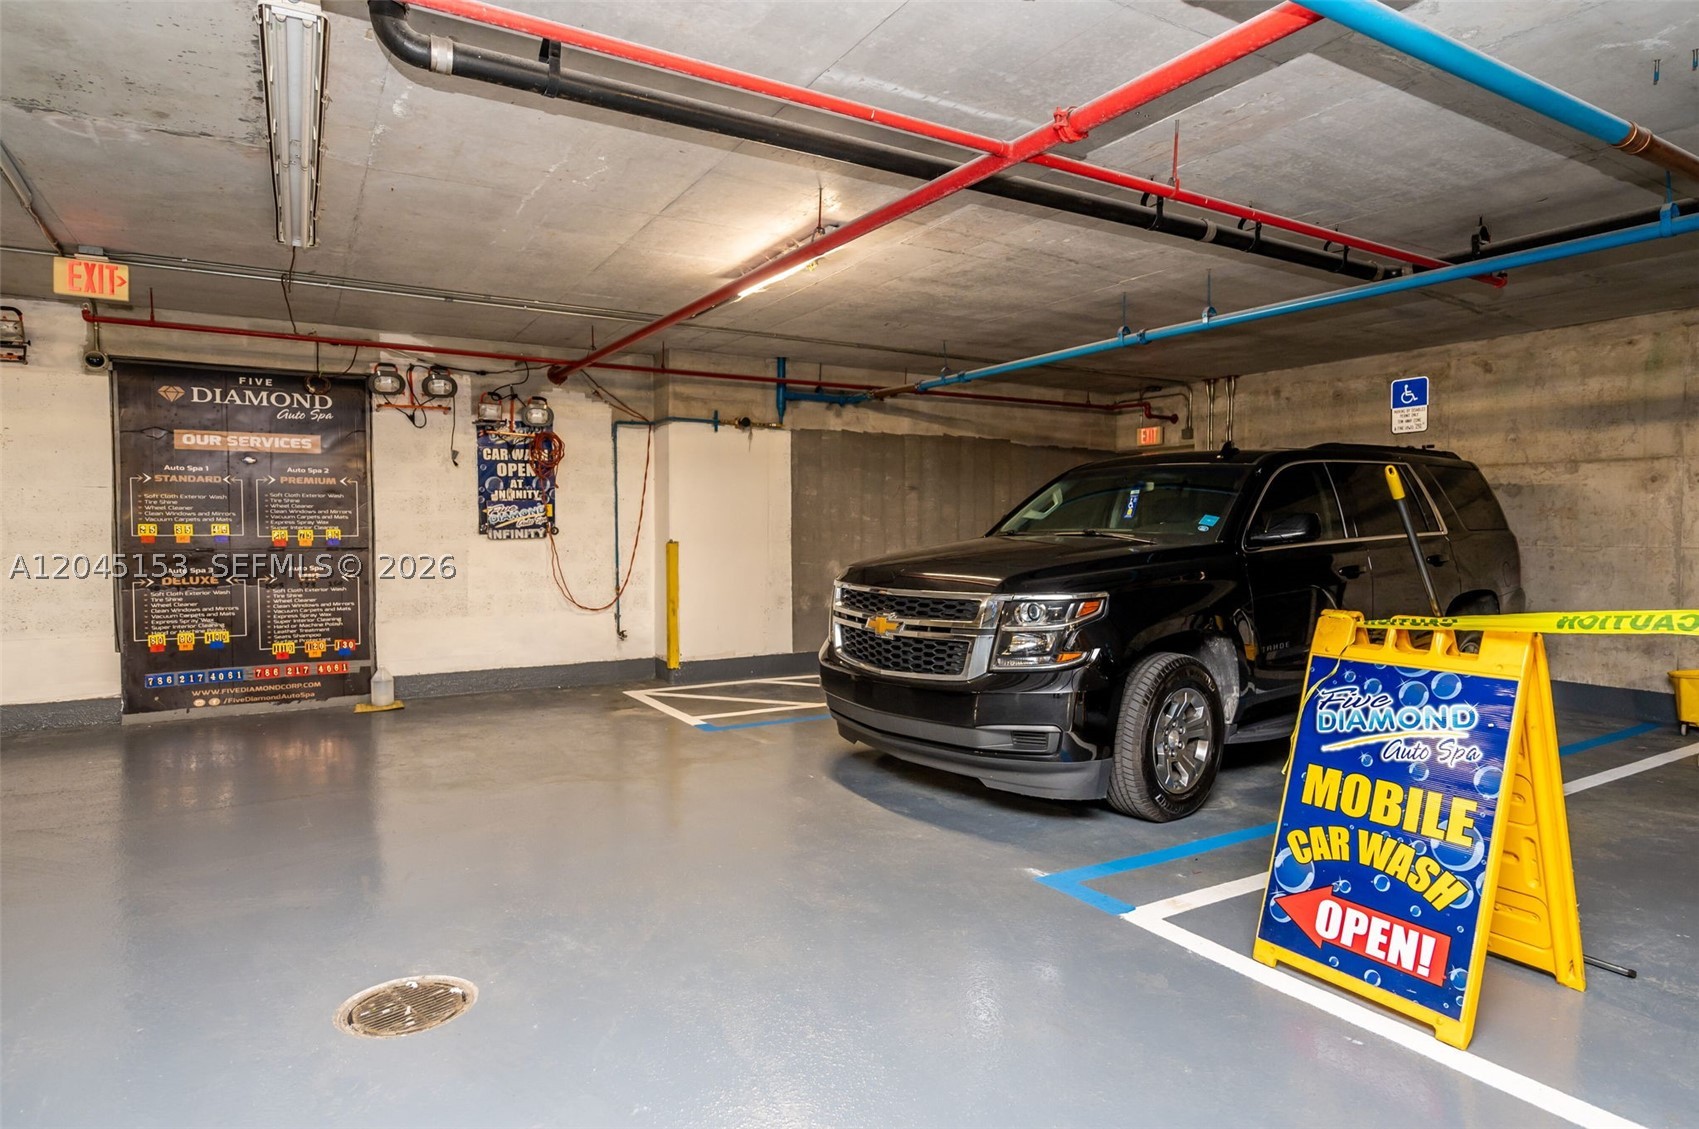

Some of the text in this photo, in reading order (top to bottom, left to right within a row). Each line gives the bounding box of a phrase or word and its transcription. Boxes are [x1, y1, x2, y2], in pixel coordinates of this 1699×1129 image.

[67, 260, 118, 296] EXIT
[239, 376, 273, 387] FIVE
[190, 386, 333, 409] DIAMOND
[277, 409, 334, 422] Auto Spa
[182, 434, 312, 449] OUR SERVICES
[482, 448, 508, 461] CAR
[496, 463, 536, 477] OPEN
[154, 474, 222, 483] STANDARD
[280, 476, 336, 485] PREMIUM
[510, 479, 524, 488] AT
[494, 489, 540, 500] ININITY
[488, 505, 546, 523] DIAMOND
[489, 504, 518, 515] Five
[516, 519, 534, 527] Auto
[488, 528, 545, 539] INFINITY
[162, 576, 219, 585] DELUXE
[1262, 640, 1290, 653] TAHOE
[256, 668, 279, 677] 786
[287, 666, 309, 674] 217
[148, 671, 241, 686] 786 217 4061
[191, 681, 321, 696] WWW.FIVEDIAMONDCORP.COM
[223, 692, 315, 704] /FiveDiamondAutoSpa
[1316, 686, 1393, 712] Five
[1316, 702, 1479, 734] DIAMOND
[1381, 738, 1484, 767] Auto Spa
[1301, 763, 1478, 848] MOBILE
[1286, 825, 1471, 912] CAR WASH
[1315, 898, 1437, 978] OPEN!
